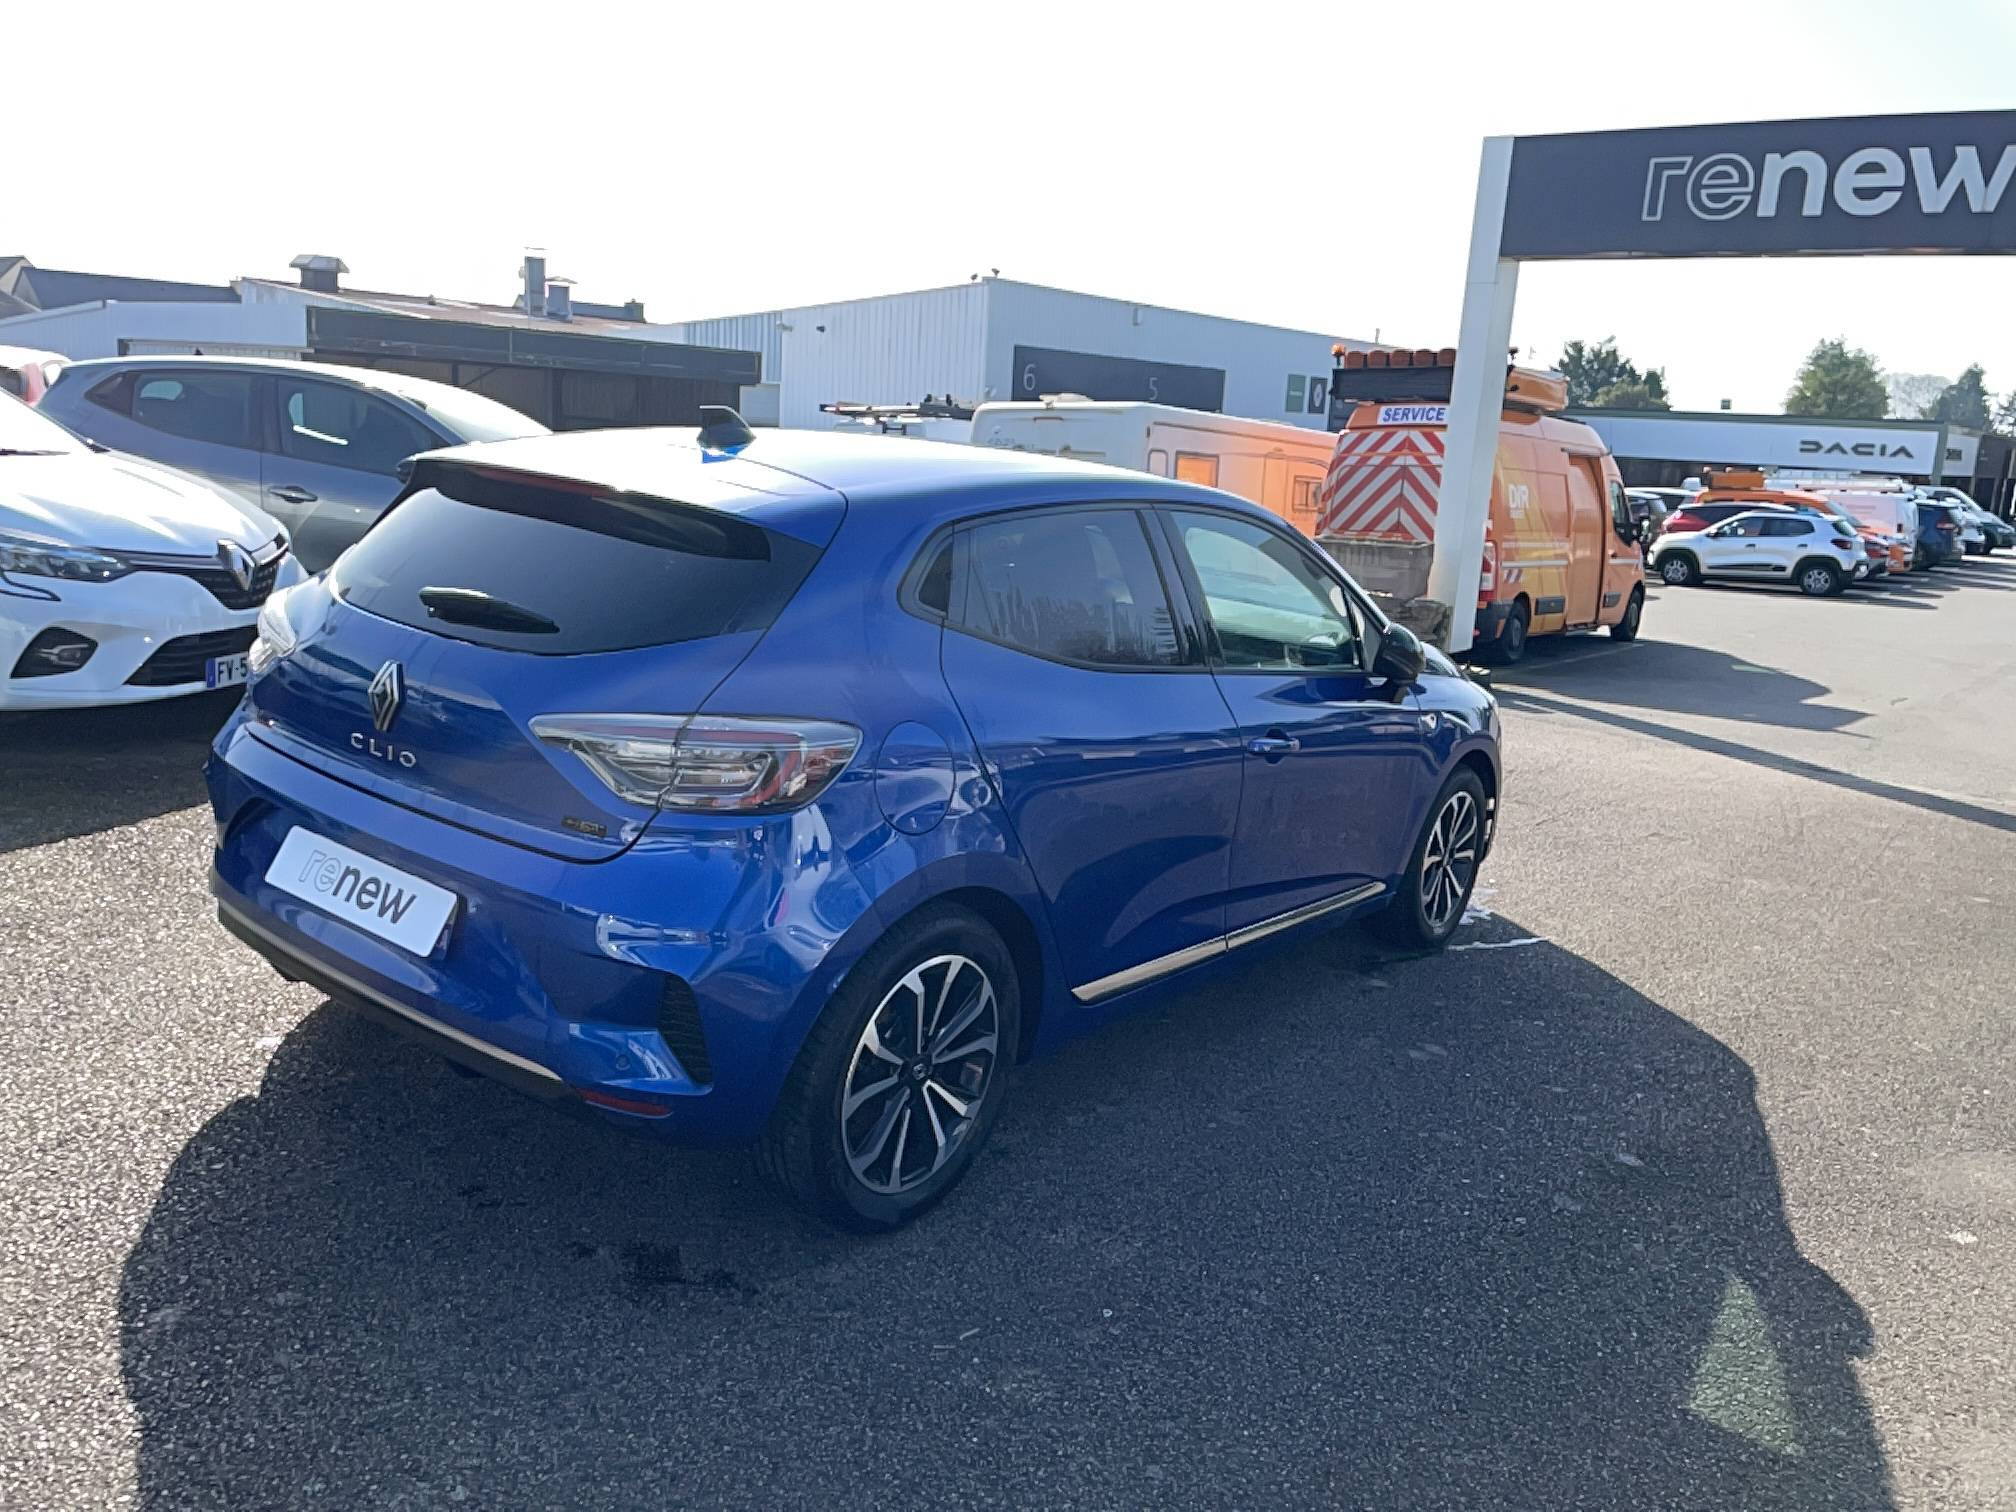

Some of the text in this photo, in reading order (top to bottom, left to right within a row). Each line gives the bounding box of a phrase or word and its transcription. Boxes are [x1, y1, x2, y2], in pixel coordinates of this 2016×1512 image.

[1641, 144, 2016, 221] renew
[1023, 363, 1036, 391] 6
[1149, 376, 1159, 401] 5
[1382, 407, 1447, 422] SERVICE
[1800, 440, 1914, 459] DACIA
[351, 732, 417, 768] CLIO
[298, 849, 417, 924] renew
